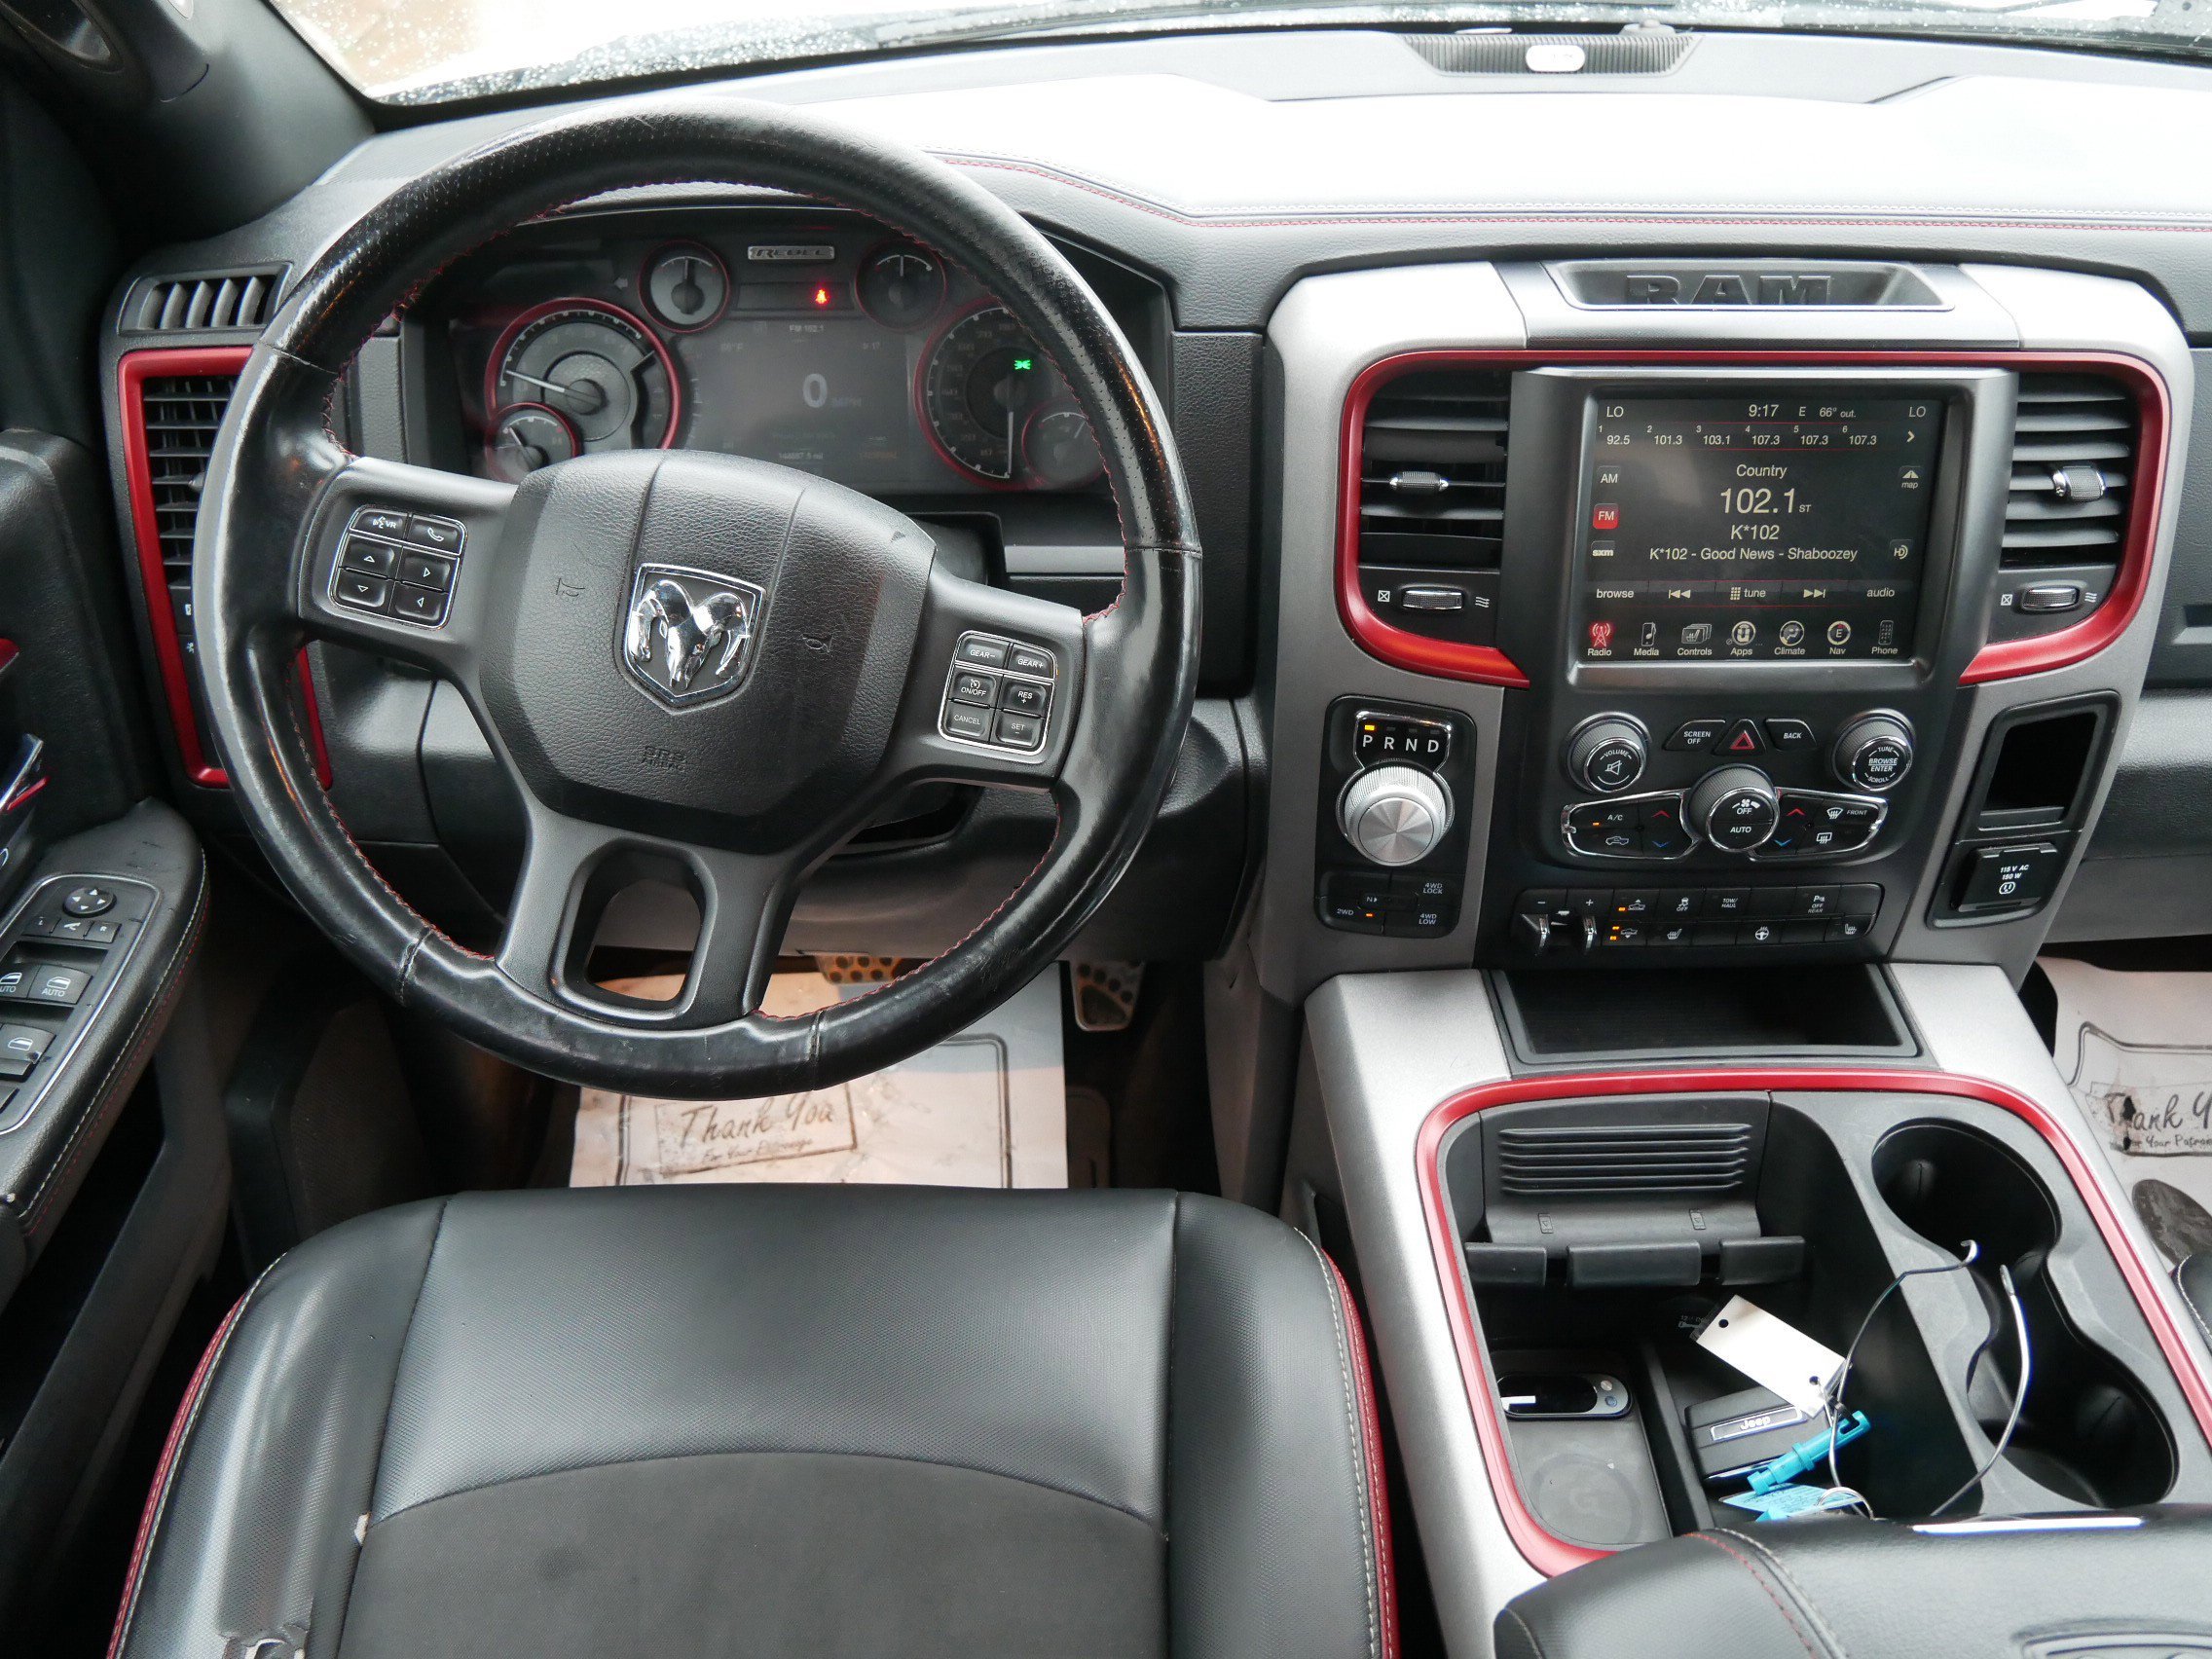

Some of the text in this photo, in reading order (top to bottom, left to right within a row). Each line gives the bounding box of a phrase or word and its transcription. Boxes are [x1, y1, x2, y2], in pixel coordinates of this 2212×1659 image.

[1626, 275, 1831, 306] RAM
[802, 373, 828, 408] 0
[1606, 405, 1624, 418] LO
[1748, 403, 1779, 418] 9:17
[1798, 406, 1807, 417] E
[1840, 410, 1857, 419] out.
[1908, 406, 1927, 418] LO
[1598, 424, 1604, 433] 1
[1646, 424, 1653, 433] 2
[1695, 424, 1702, 433] 3
[1745, 424, 1751, 433] 4
[1793, 424, 1799, 433] 5
[1842, 424, 1848, 433] 6
[1606, 434, 1631, 445] 92.5
[1654, 434, 1682, 445] 101.3
[1703, 434, 1731, 445] 103.1
[1751, 434, 1781, 445] 107.3
[1800, 434, 1829, 445] 107.3
[1849, 434, 1877, 445] 107.3
[1736, 463, 1788, 479] Country
[1601, 473, 1618, 484] AM
[1719, 488, 1812, 514] 102.1 ST
[1598, 510, 1615, 521] FM
[1700, 548, 1736, 561] Good
[1739, 548, 1775, 561] News
[1788, 548, 1859, 562] Shaboozey
[1596, 587, 1635, 599] browse
[1744, 588, 1766, 598] tune
[1866, 586, 1896, 598] audio
[1587, 646, 1612, 656] Radio
[1633, 646, 1660, 656] Media
[1677, 646, 1713, 656] Controls
[1730, 646, 1753, 657] Apps
[1774, 646, 1806, 655] Climate
[1828, 646, 1847, 655] Nav
[1870, 646, 1899, 655] Phone
[1017, 690, 1033, 699] RES
[953, 714, 981, 725] CANCEL
[1362, 734, 1440, 753] P R N D
[1603, 749, 1630, 757] VOLUME
[41, 988, 66, 997] AUTO
[2104, 1091, 2184, 1132] Tank
[681, 1095, 775, 1149] Thank
[1740, 1417, 1771, 1430] Jeep
